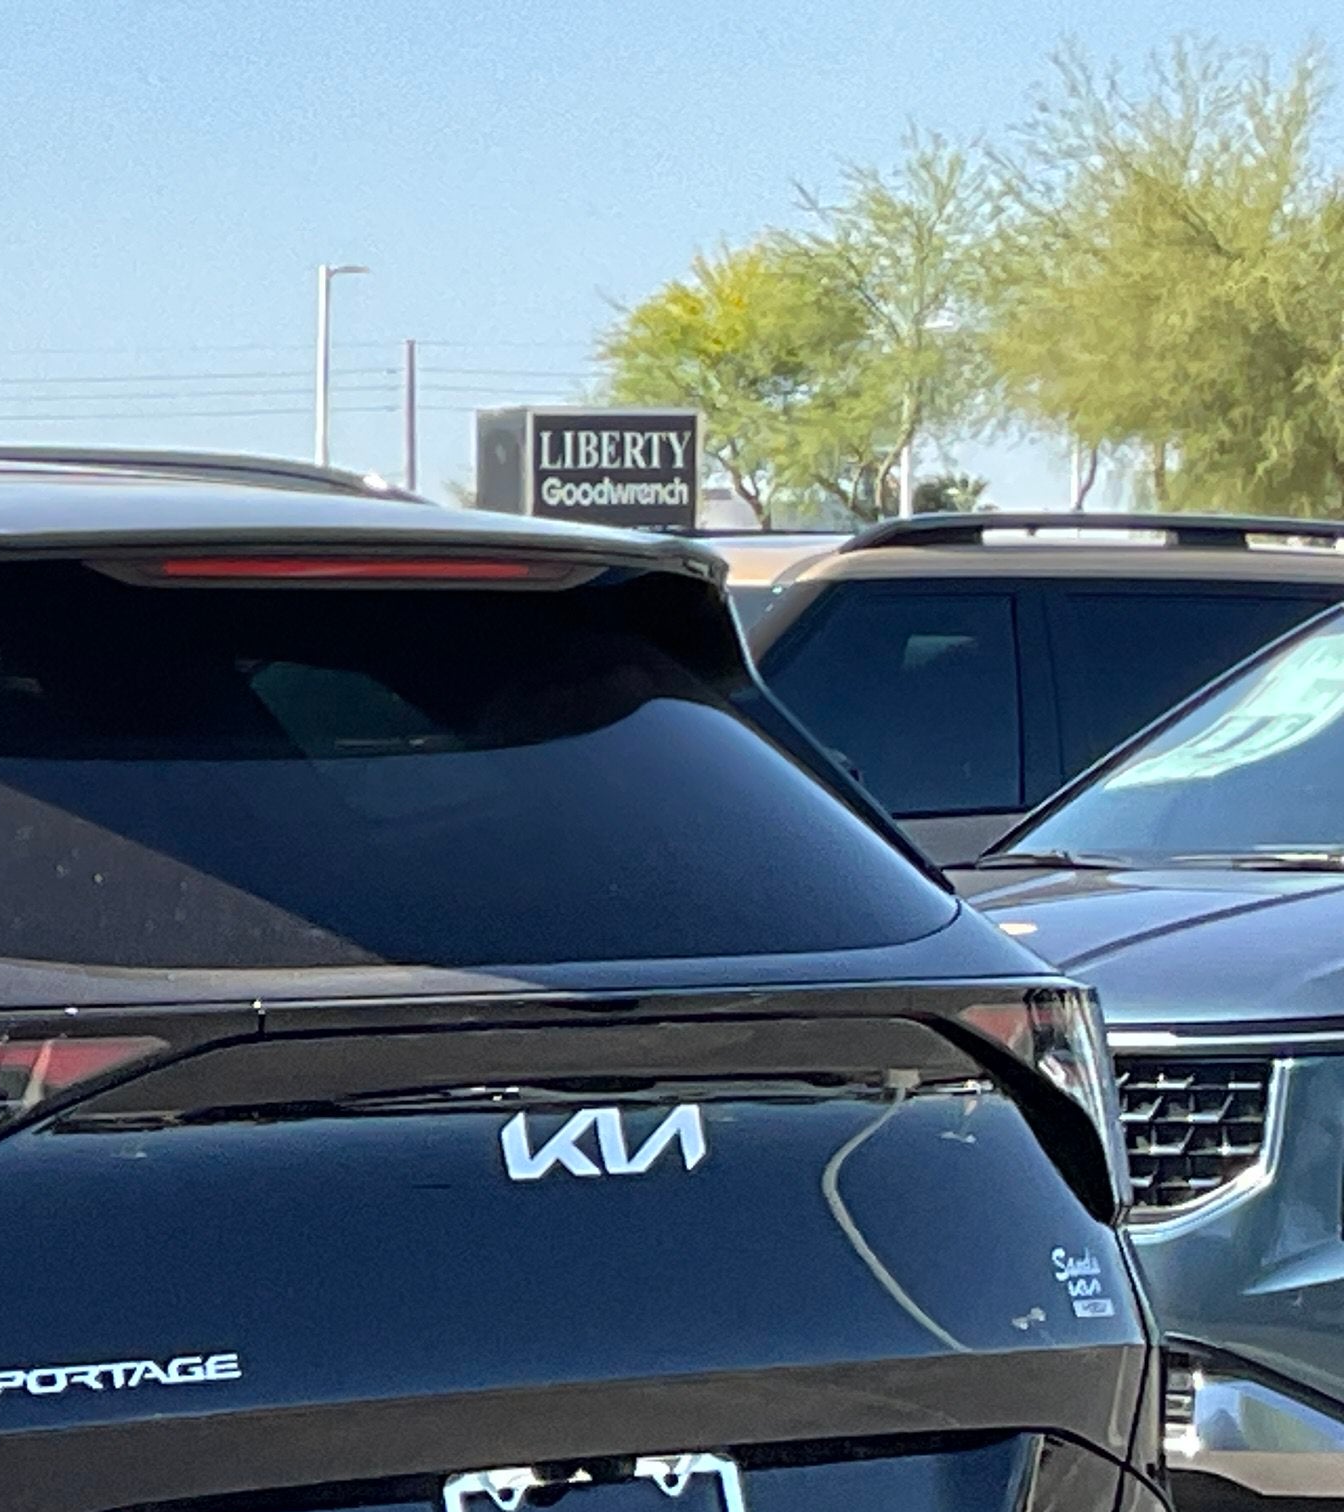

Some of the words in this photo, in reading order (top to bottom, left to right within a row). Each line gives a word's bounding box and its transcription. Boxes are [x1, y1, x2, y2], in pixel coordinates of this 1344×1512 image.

[538, 430, 692, 470] LIBERTY
[541, 476, 689, 506] Goodwrench
[501, 1104, 706, 1179] KIA
